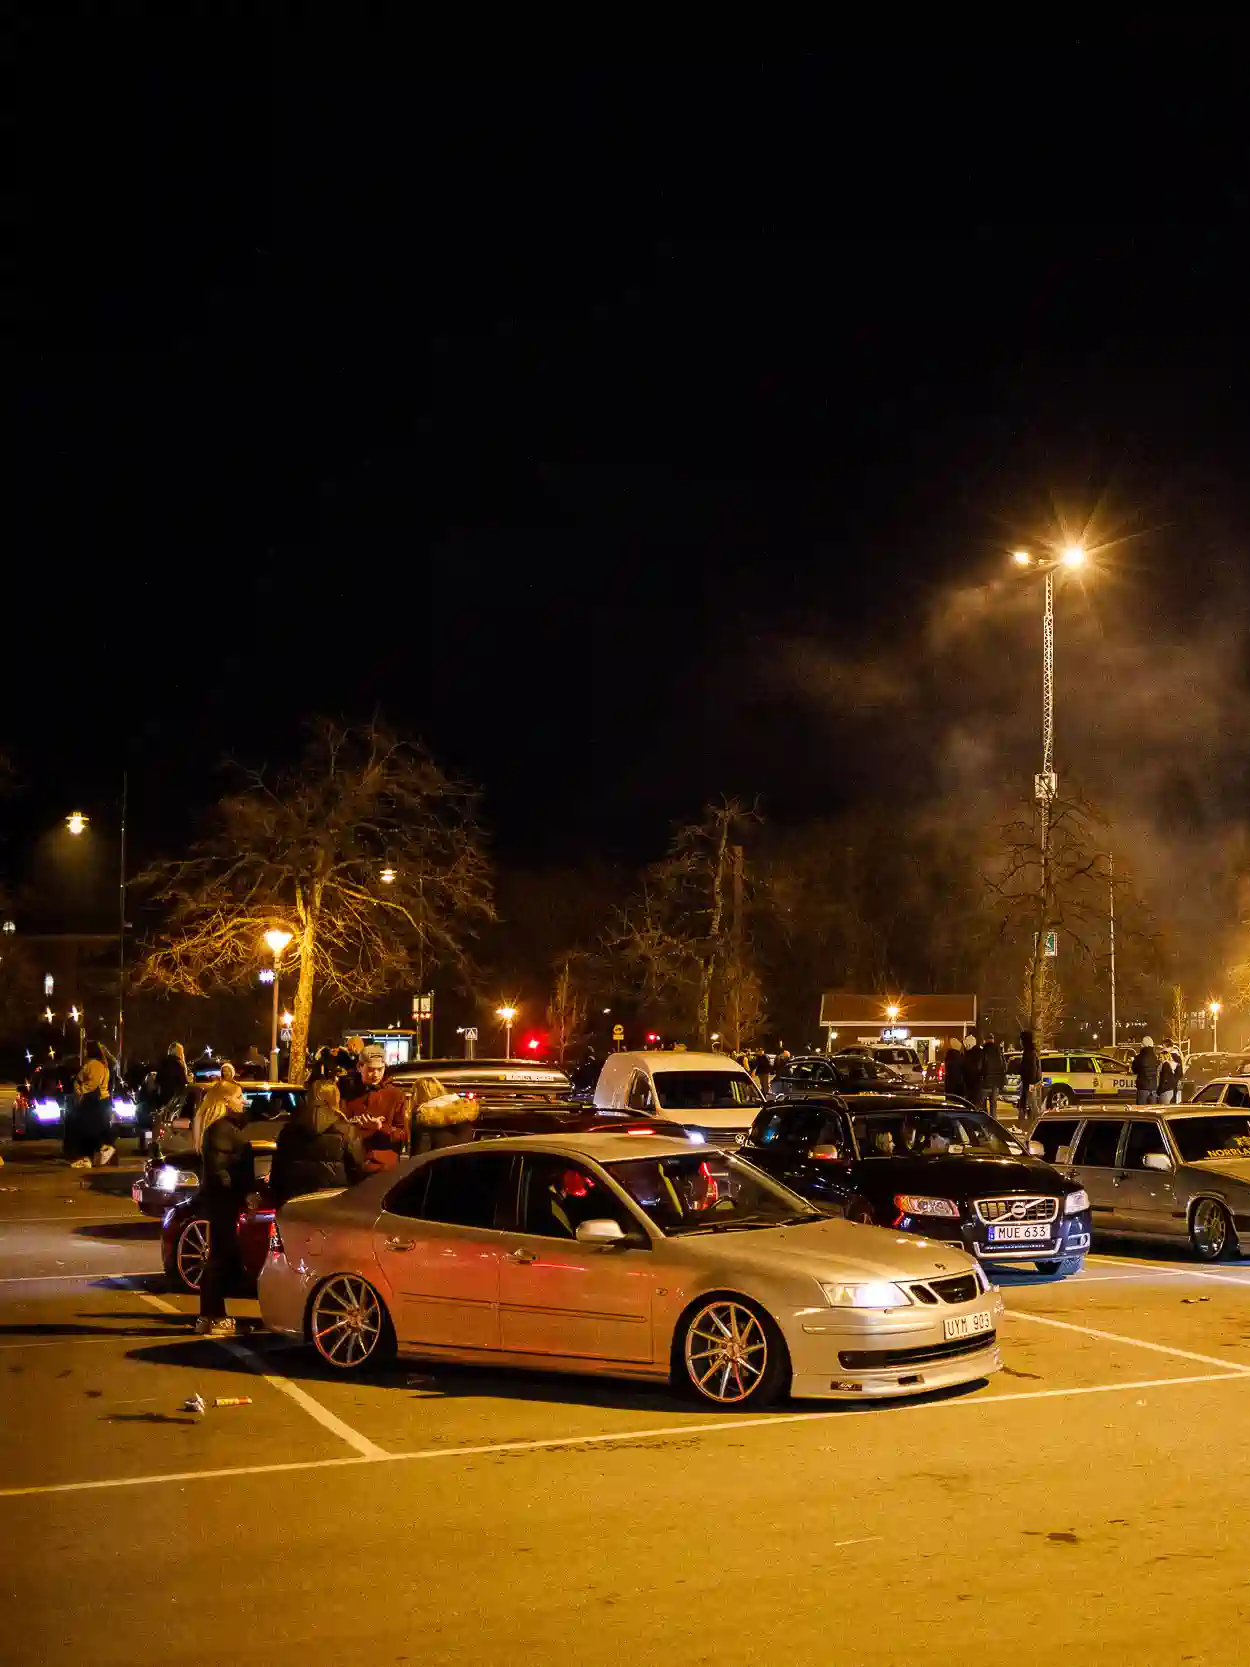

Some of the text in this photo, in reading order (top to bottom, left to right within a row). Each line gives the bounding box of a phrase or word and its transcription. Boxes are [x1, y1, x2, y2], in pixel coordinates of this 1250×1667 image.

[998, 1226, 1046, 1239] MUE 633
[947, 1313, 990, 1336] UYM 903
